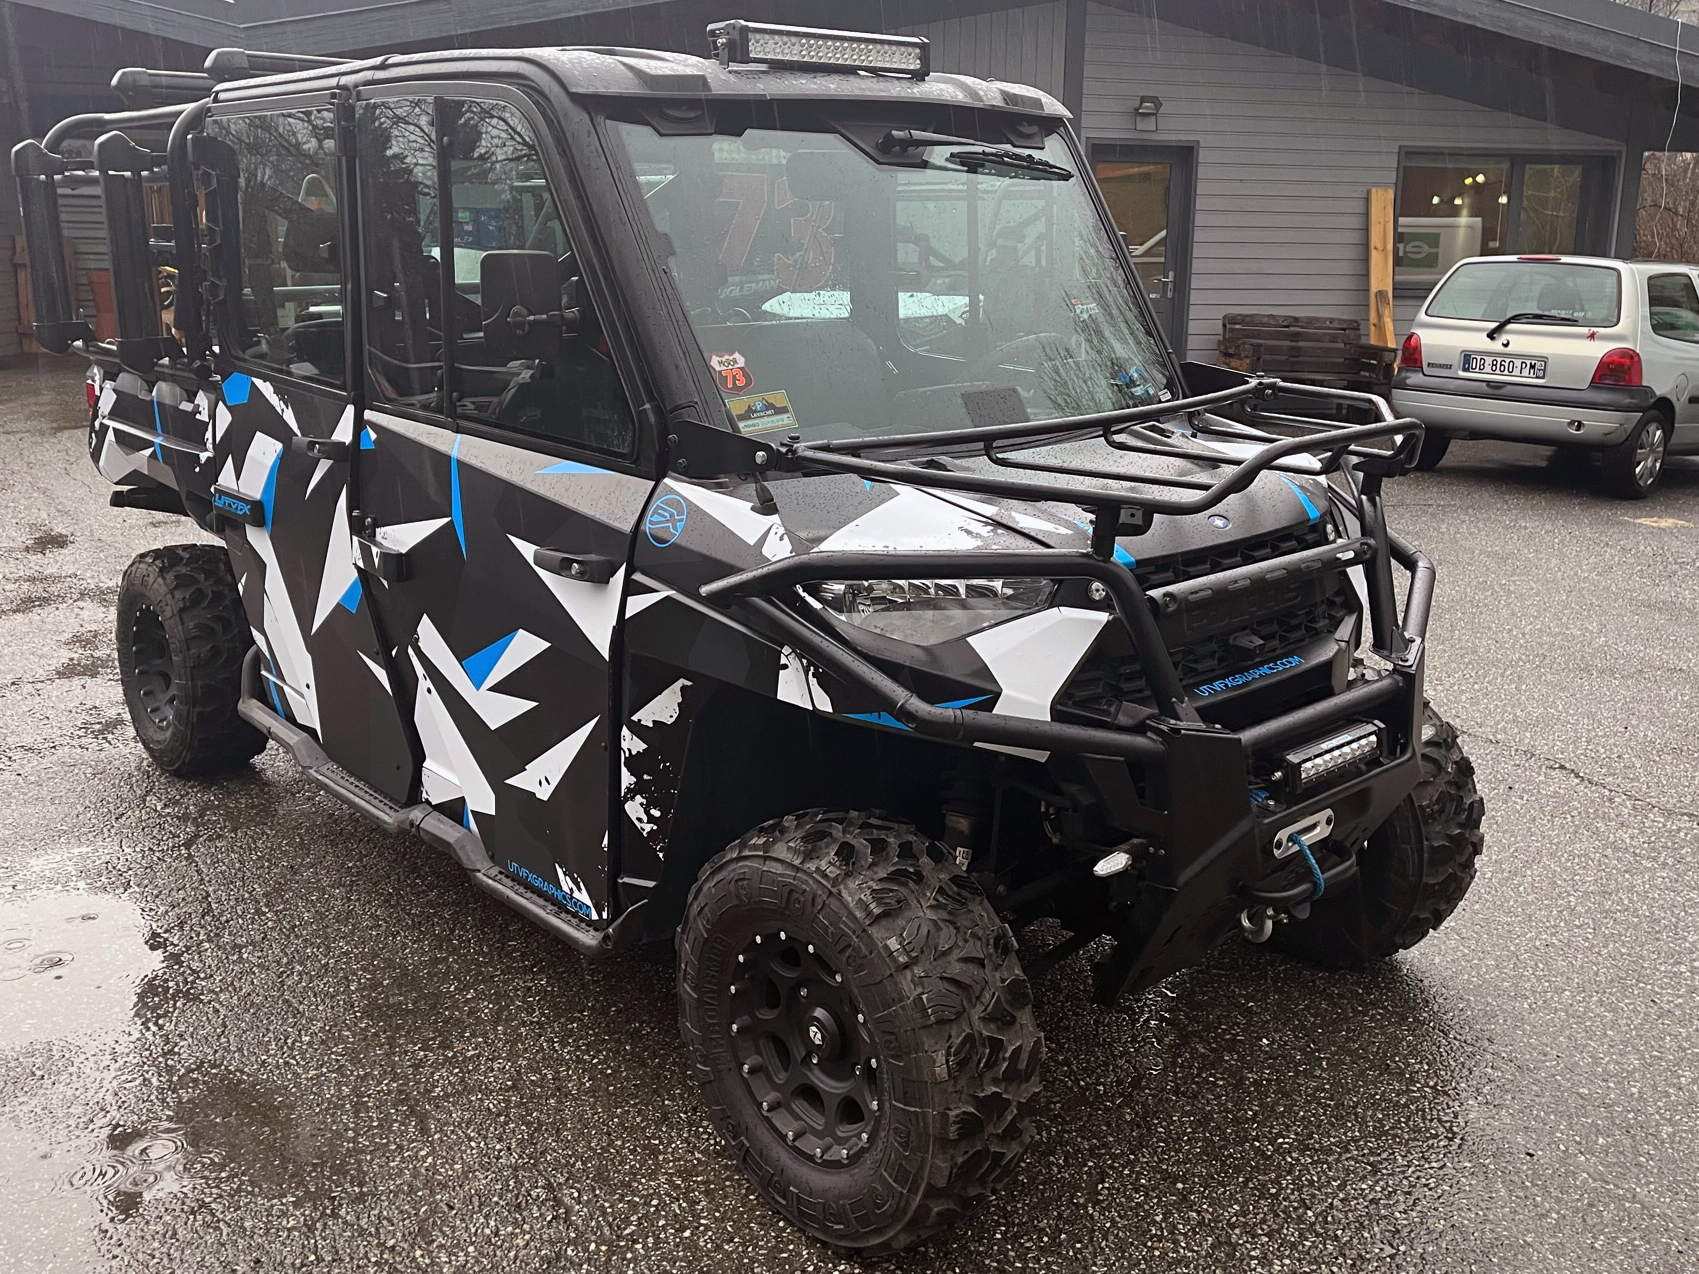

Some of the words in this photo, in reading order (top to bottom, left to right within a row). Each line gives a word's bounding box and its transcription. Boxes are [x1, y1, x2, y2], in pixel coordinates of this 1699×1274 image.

[717, 357, 739, 368] MOTOR
[721, 368, 746, 388] 73
[755, 401, 763, 411] P
[215, 493, 251, 515] UTVFX
[1194, 655, 1306, 697] UTVFXGRAPHICS.COM
[507, 859, 592, 920] UTVFXGRAPHICS.COM
